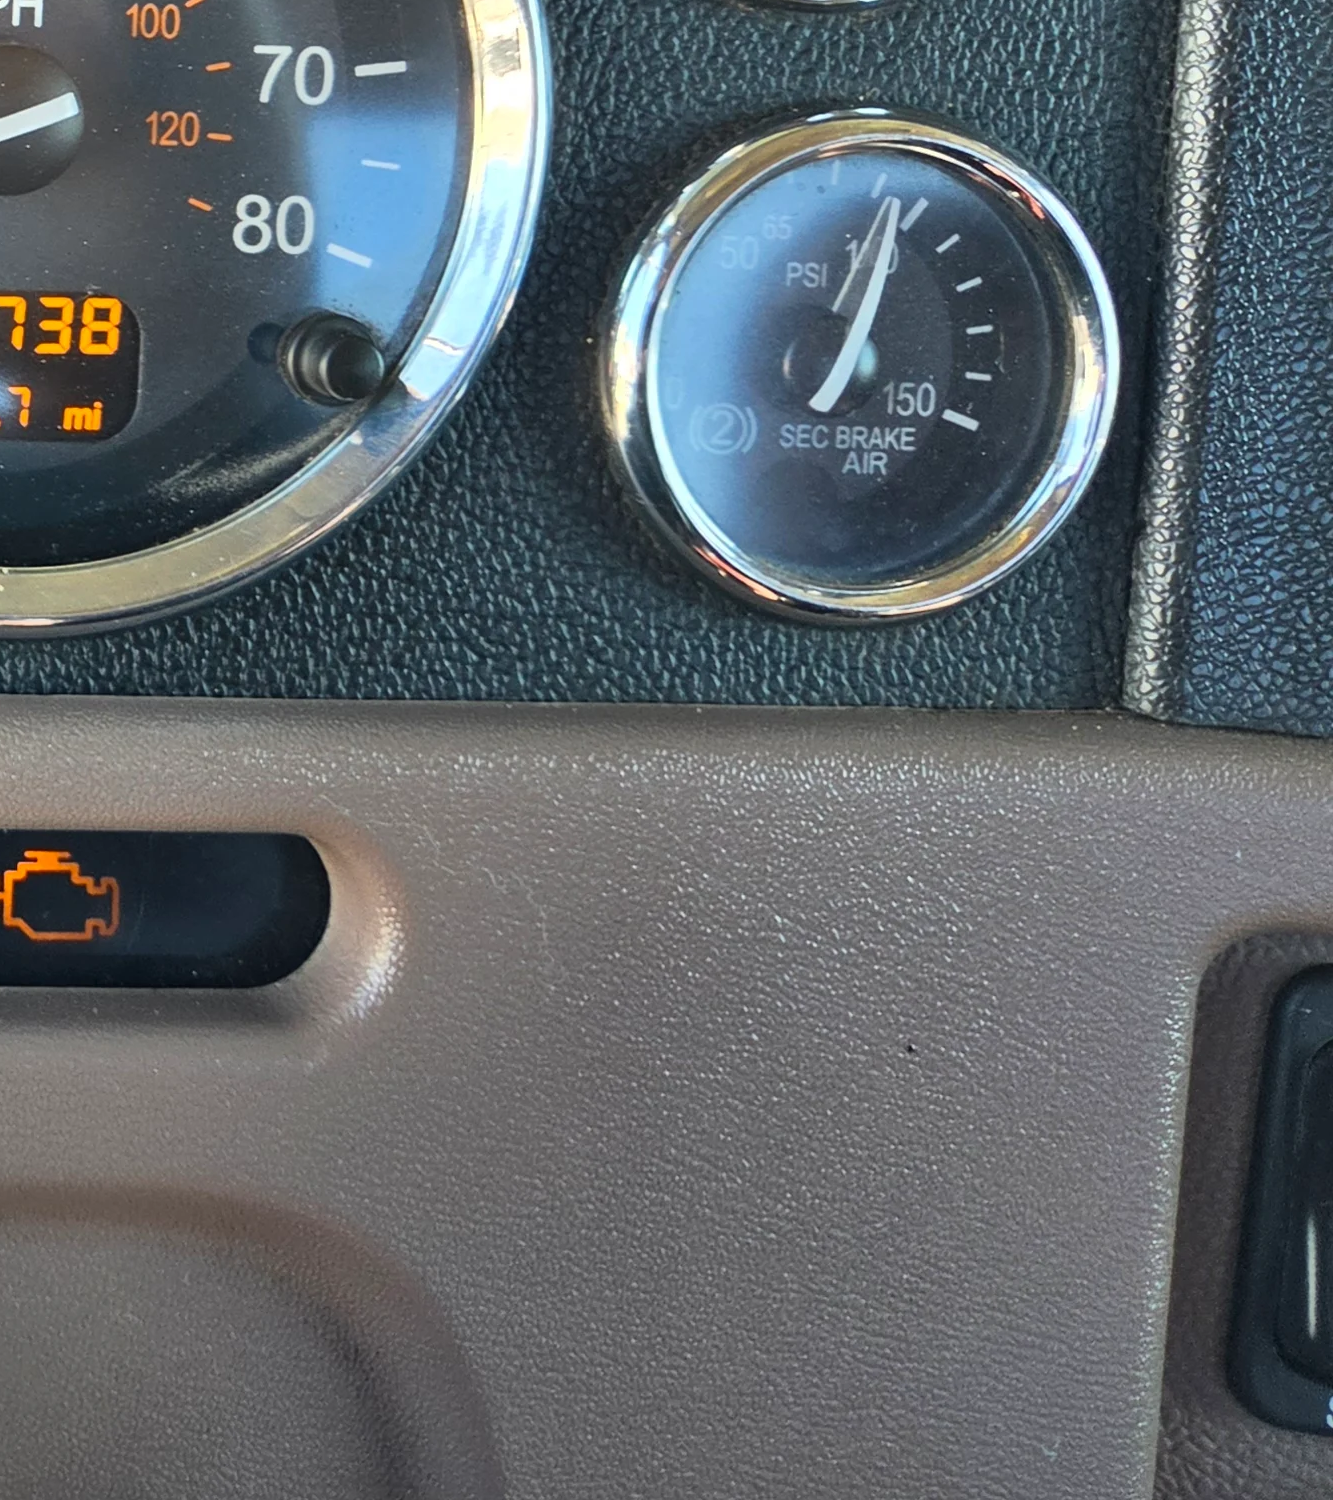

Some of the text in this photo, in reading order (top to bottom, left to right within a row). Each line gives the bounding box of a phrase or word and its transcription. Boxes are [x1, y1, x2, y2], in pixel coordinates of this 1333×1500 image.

[127, 3, 181, 39] 100
[253, 46, 334, 105] 70
[146, 112, 199, 148] 120
[232, 194, 315, 255] 80
[719, 236, 760, 270] 50
[786, 262, 827, 288] PSI
[63, 400, 104, 433] mi
[882, 383, 936, 417] 150
[779, 424, 916, 451] SEC BRAKE
[842, 451, 887, 475] AIR
